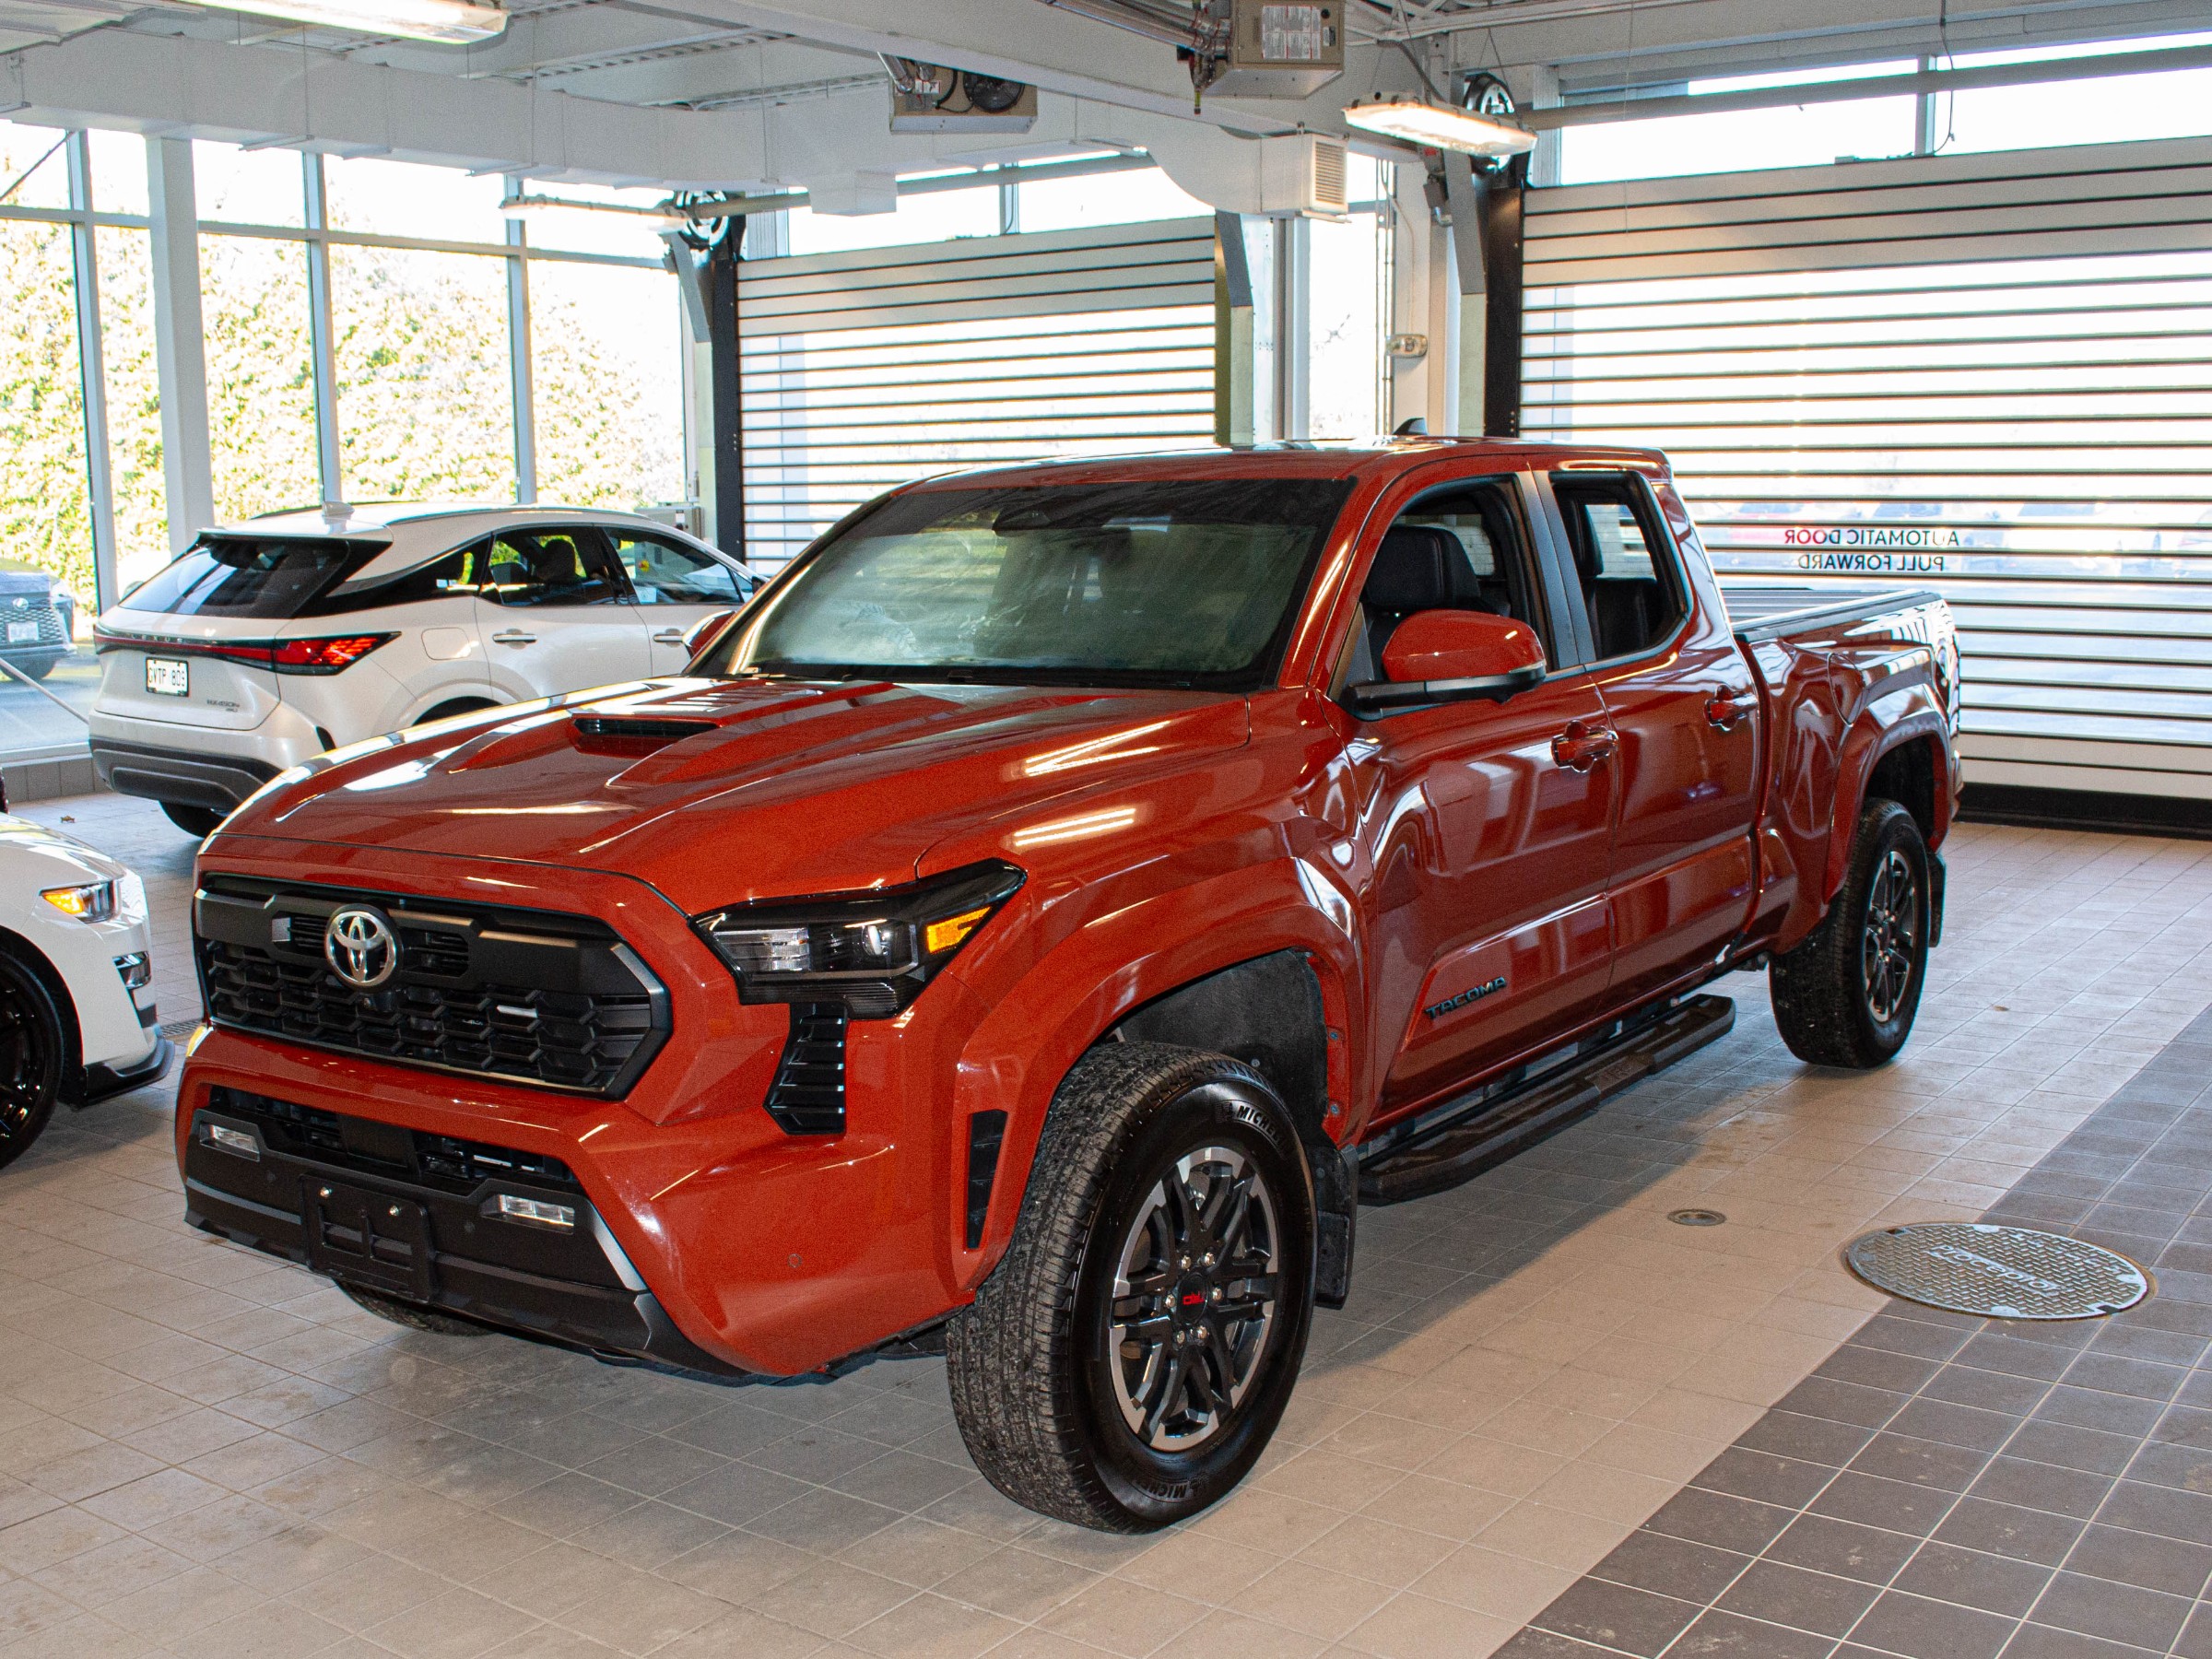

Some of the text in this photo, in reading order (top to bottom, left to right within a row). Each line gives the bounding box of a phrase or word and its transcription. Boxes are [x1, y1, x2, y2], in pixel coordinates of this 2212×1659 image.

[131, 633, 183, 643] LEXUS
[1425, 977, 1506, 1019] TACOMA
[1236, 1104, 1287, 1151] MICHEL
